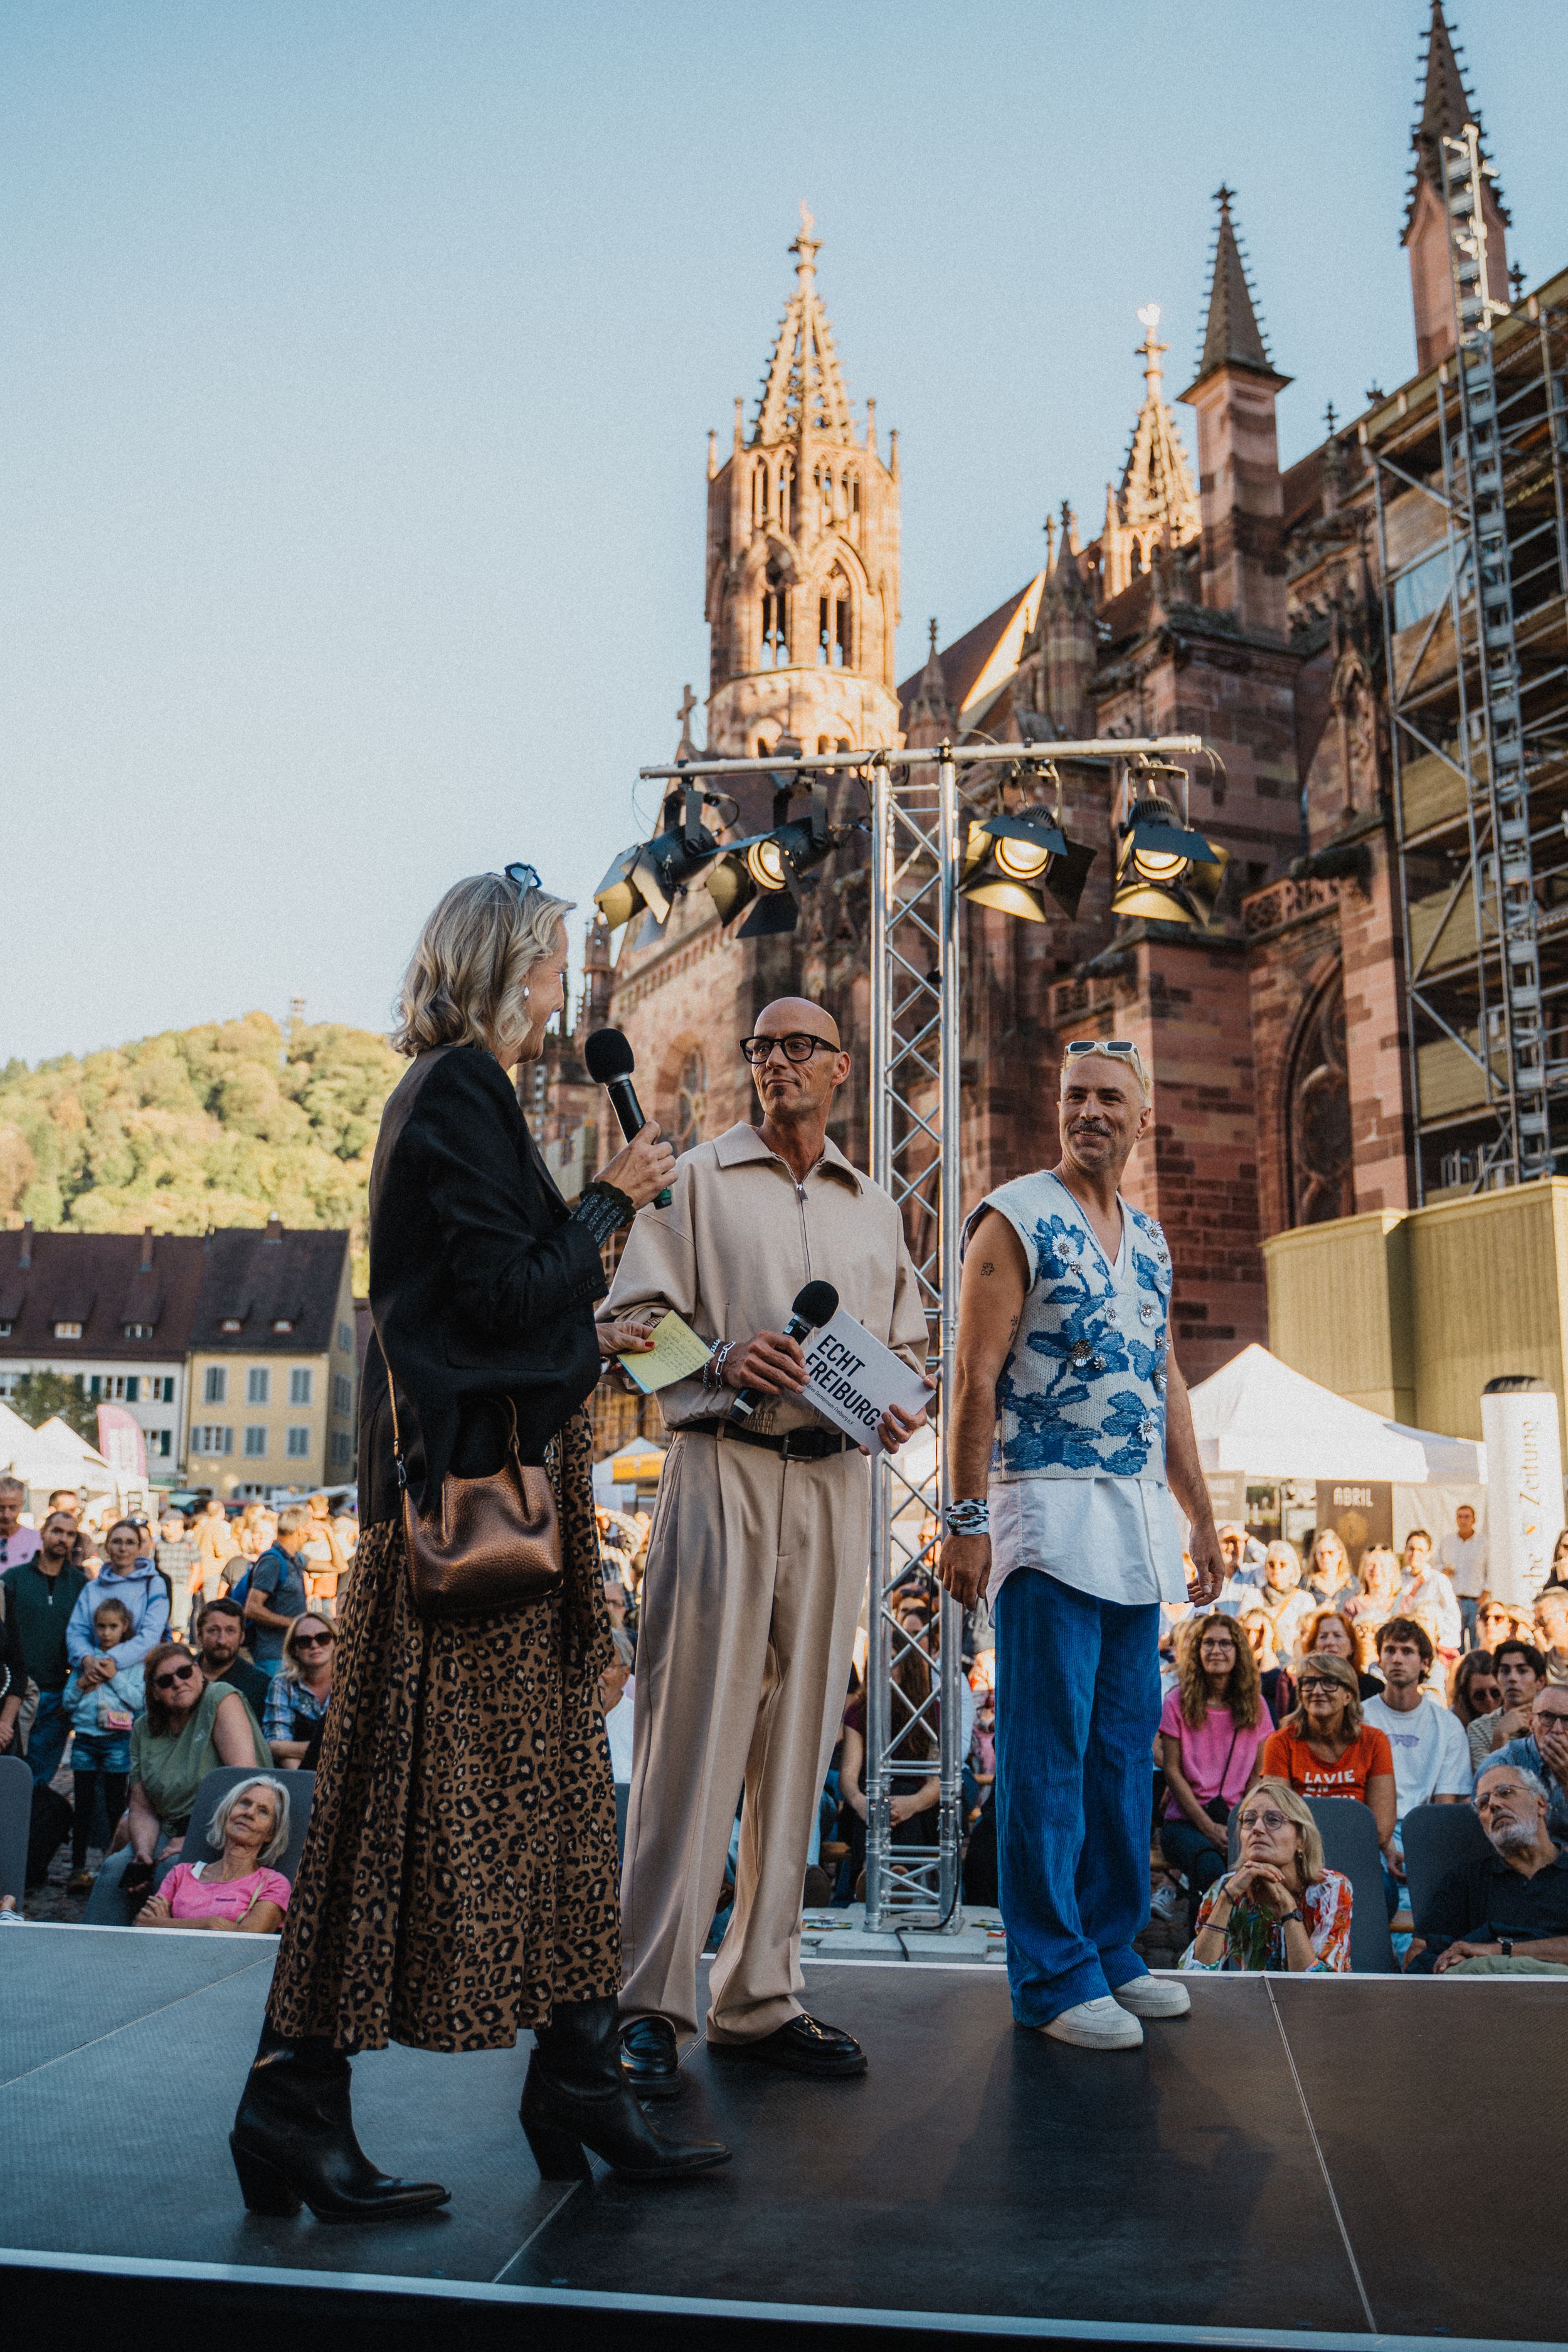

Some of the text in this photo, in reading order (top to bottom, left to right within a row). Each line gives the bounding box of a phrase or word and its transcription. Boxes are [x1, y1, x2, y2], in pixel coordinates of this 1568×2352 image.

[817, 1334, 866, 1377] ECHT
[805, 1353, 881, 1431] FREIBURG.
[815, 1391, 835, 1409] Gemeinsam
[834, 1406, 848, 1422] Freiburg
[1519, 1419, 1540, 1505] Zeitung
[1333, 1486, 1374, 1507] ABRIL
